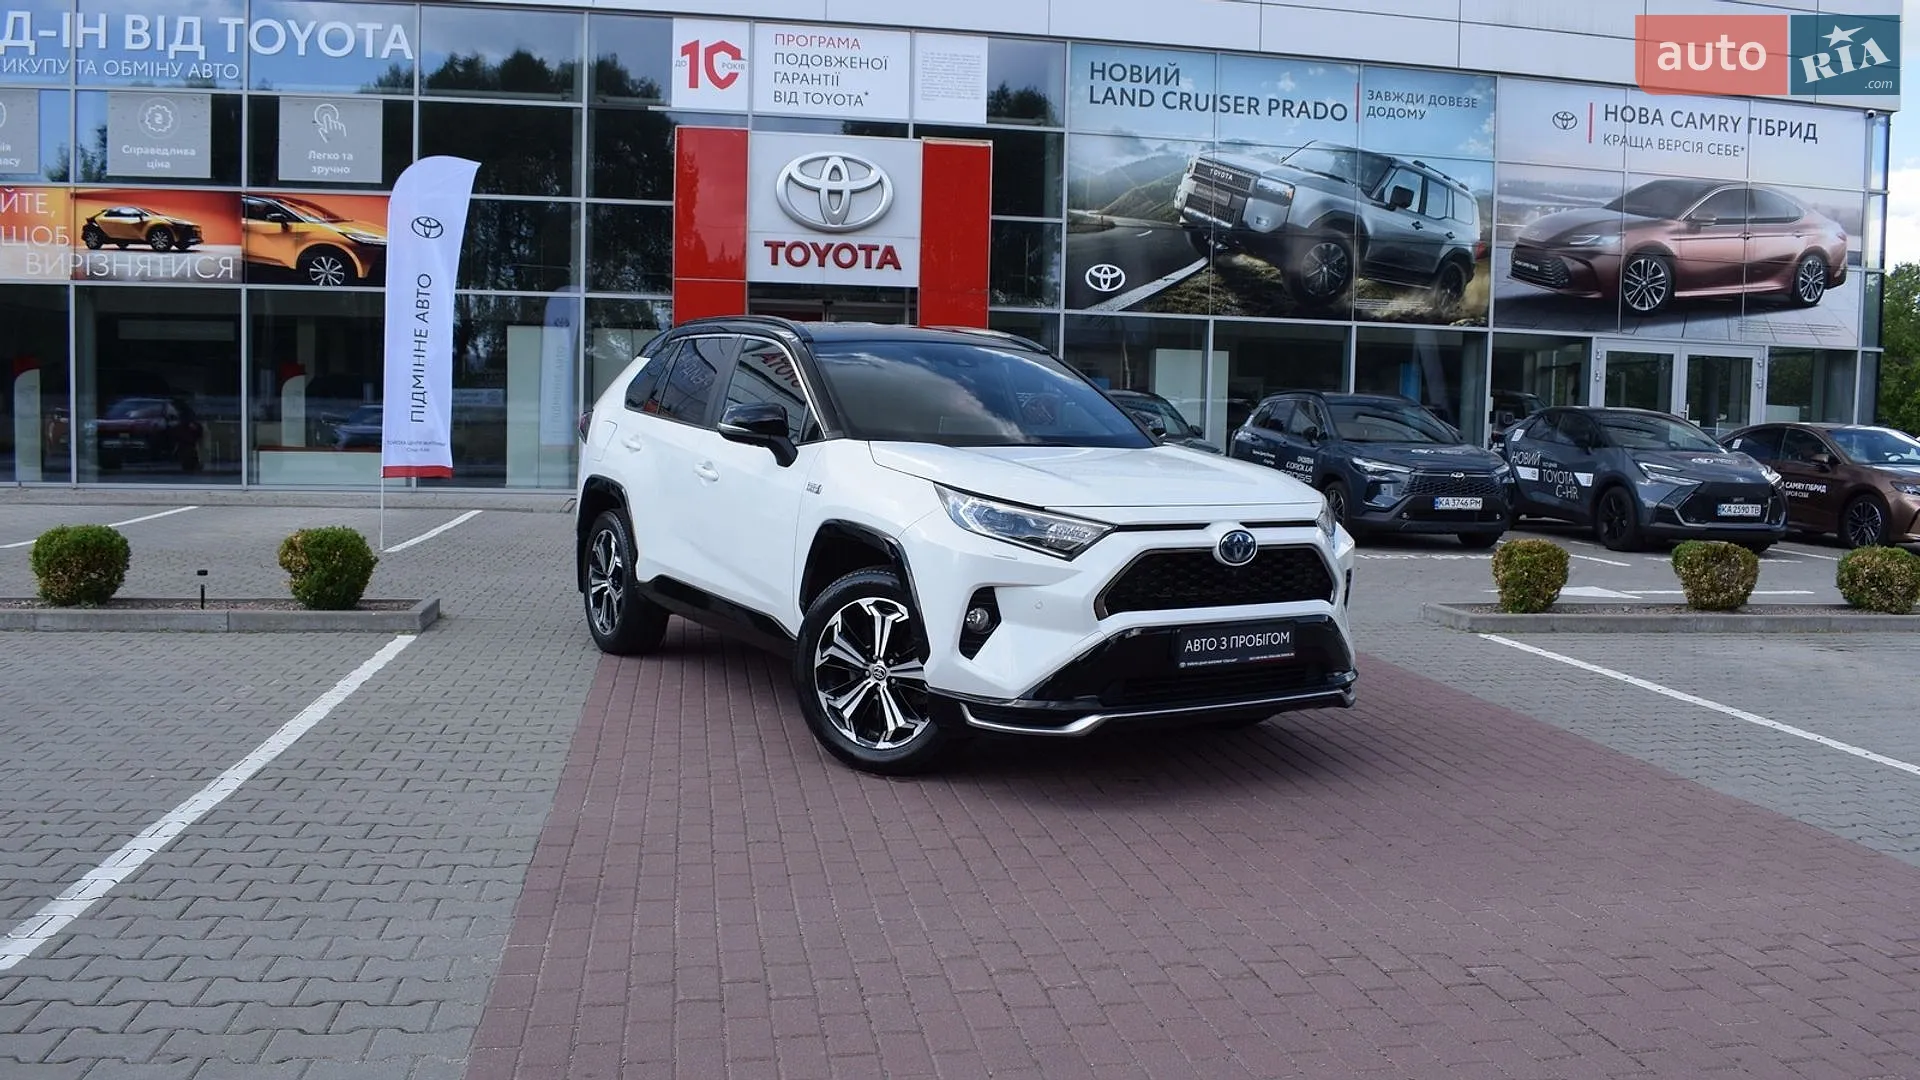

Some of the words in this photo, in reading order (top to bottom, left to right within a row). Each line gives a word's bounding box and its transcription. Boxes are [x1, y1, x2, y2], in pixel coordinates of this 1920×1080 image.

[124, 13, 206, 60] ВІД
[218, 17, 414, 60] TOYOTA
[774, 33, 861, 49] ПРОГРАМА
[76, 58, 98, 75] ТА
[103, 60, 183, 77] ОБМІНУ
[188, 63, 240, 79] АВТО
[774, 52, 889, 70] ПОДОВЖЕНОЇ
[774, 71, 840, 87] ГАРАНТІЇ
[1090, 61, 1180, 86] НОВИЙ
[774, 90, 799, 106] ВІД
[1089, 85, 1155, 107] LAND
[1162, 91, 1260, 115] CRUISER
[1268, 98, 1348, 121] PRADO
[1367, 89, 1424, 105] ЗАВЖДИ
[1428, 94, 1477, 108] ДОВЕЗЕ
[1366, 106, 1427, 120] ДОДОМУ
[1604, 104, 1664, 126] НОВА
[1671, 110, 1742, 133] CAMRY
[1747, 117, 1818, 144] ГІБРИД
[1603, 133, 1653, 150] КРАЩА
[1658, 138, 1703, 153] ВЕРСІЯ
[308, 150, 340, 160] Легко
[312, 166, 350, 175] зручно
[1, 188, 56, 218] ЙТЕ,
[1, 225, 70, 249] ЩОБ
[26, 252, 234, 279] ВИРІЗНЯТИСЯ
[763, 240, 902, 271] TOYOTA
[416, 273, 432, 323] АВТО
[410, 327, 429, 423] ПІДМІННЕ
[1511, 451, 1541, 466] НОВИЙ
[1542, 469, 1575, 485] TOYOTA
[1555, 484, 1579, 499] C-HR
[1184, 638, 1217, 652] АВТО
[1220, 637, 1227, 649] З
[1230, 631, 1290, 648] ПРОБІГОМ
